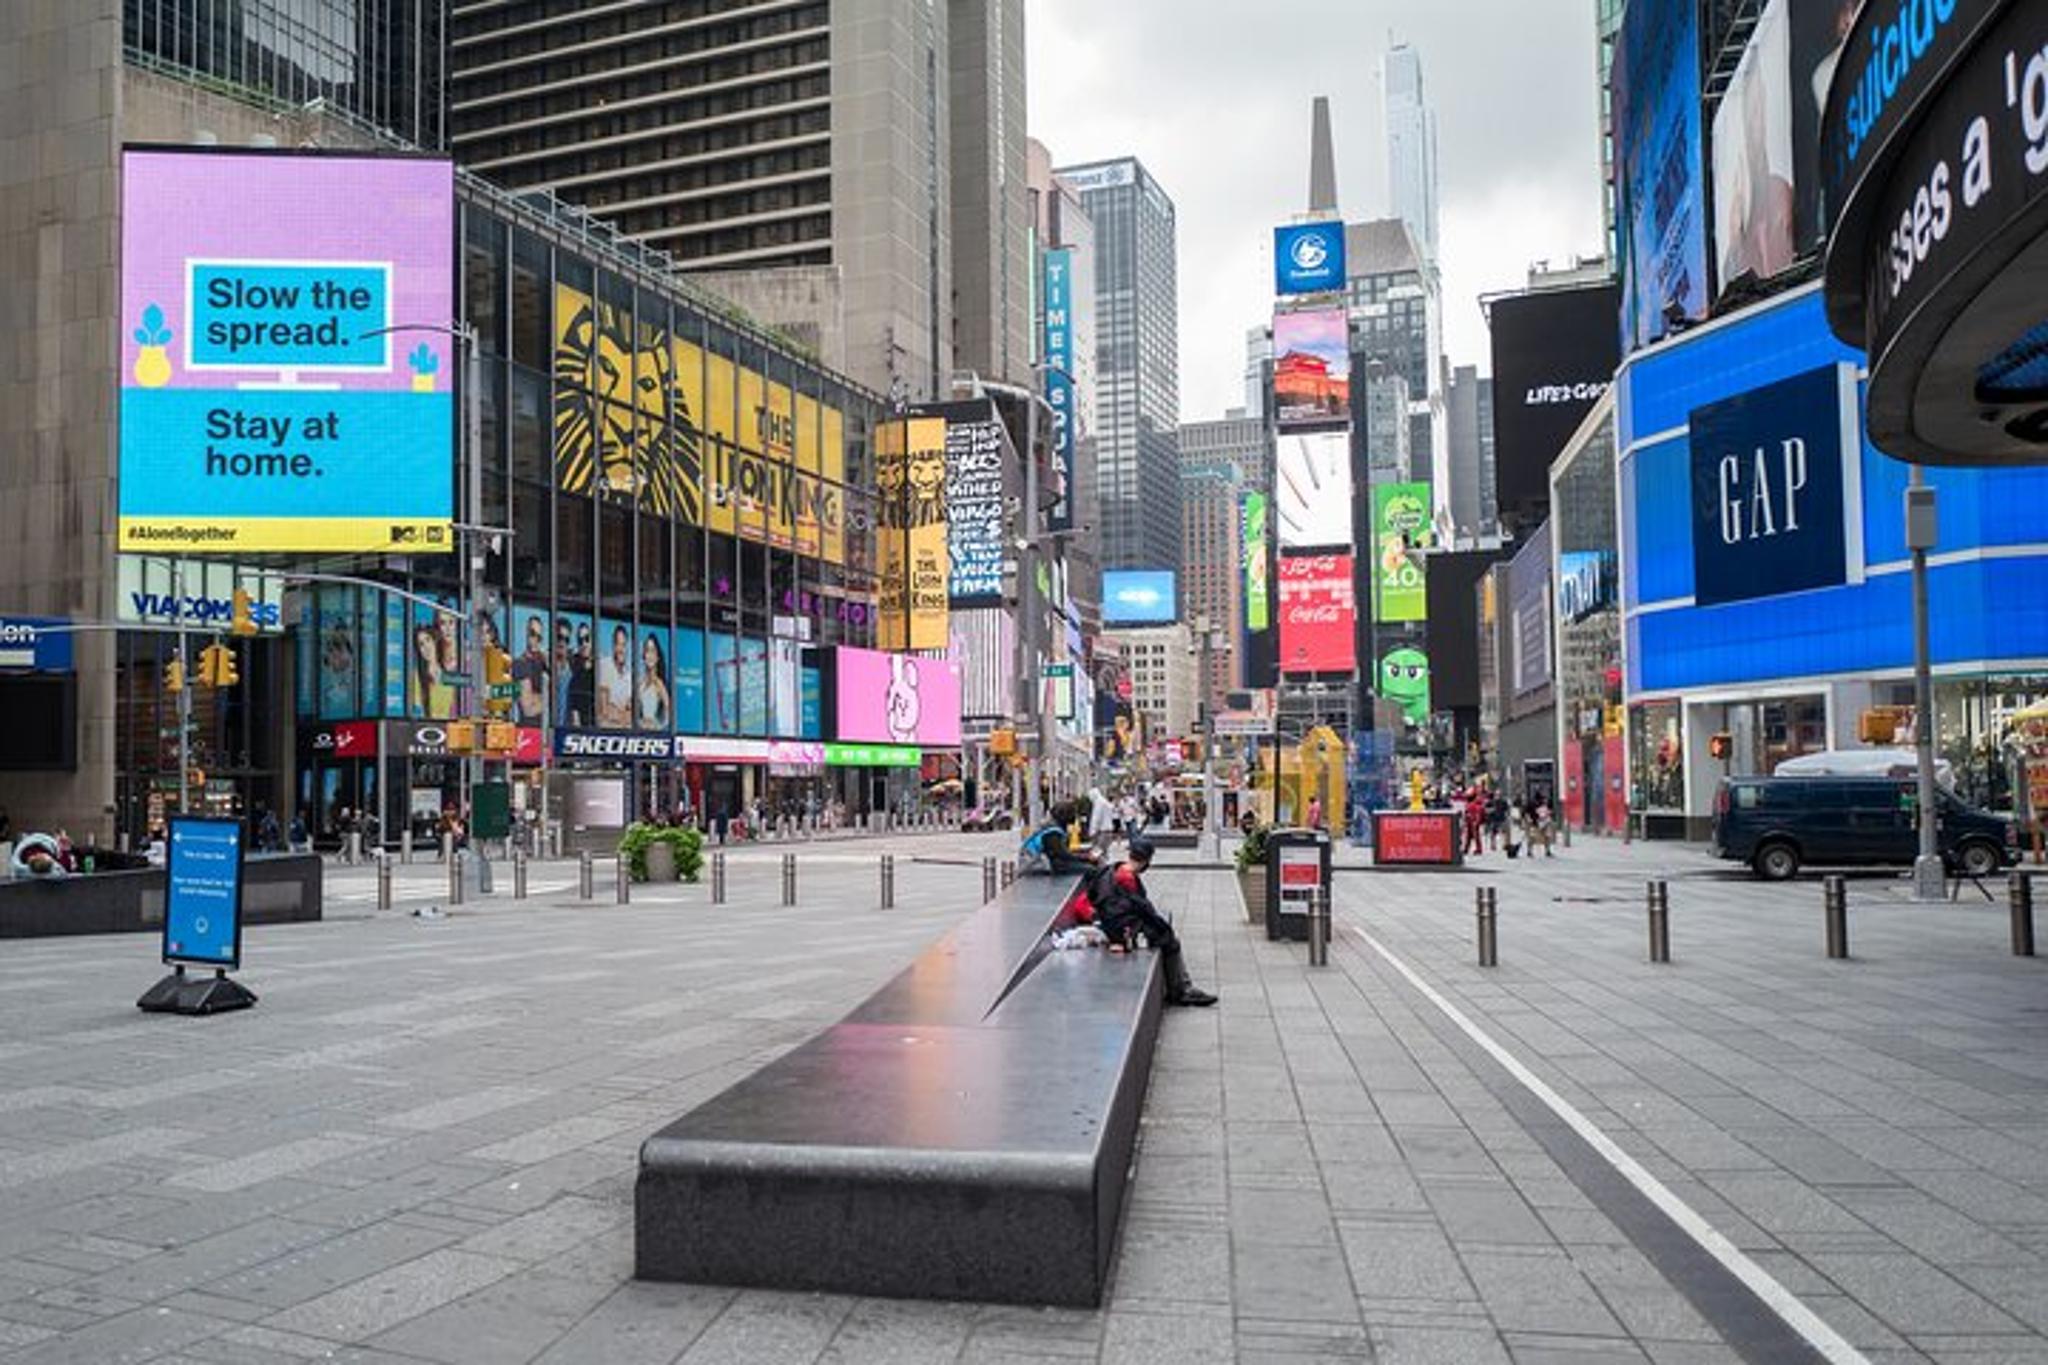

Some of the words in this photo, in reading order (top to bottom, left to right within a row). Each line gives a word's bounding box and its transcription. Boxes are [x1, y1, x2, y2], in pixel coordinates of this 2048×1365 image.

[1962, 115, 1992, 207] a
[208, 278, 300, 310] Slow
[311, 281, 371, 311] the
[208, 316, 349, 353] spread.
[206, 408, 291, 447] Stay
[303, 411, 339, 441] at
[754, 406, 791, 446] THE
[206, 446, 324, 477] home.
[1719, 438, 1807, 544] GAP
[562, 734, 670, 756] SKECHERS
